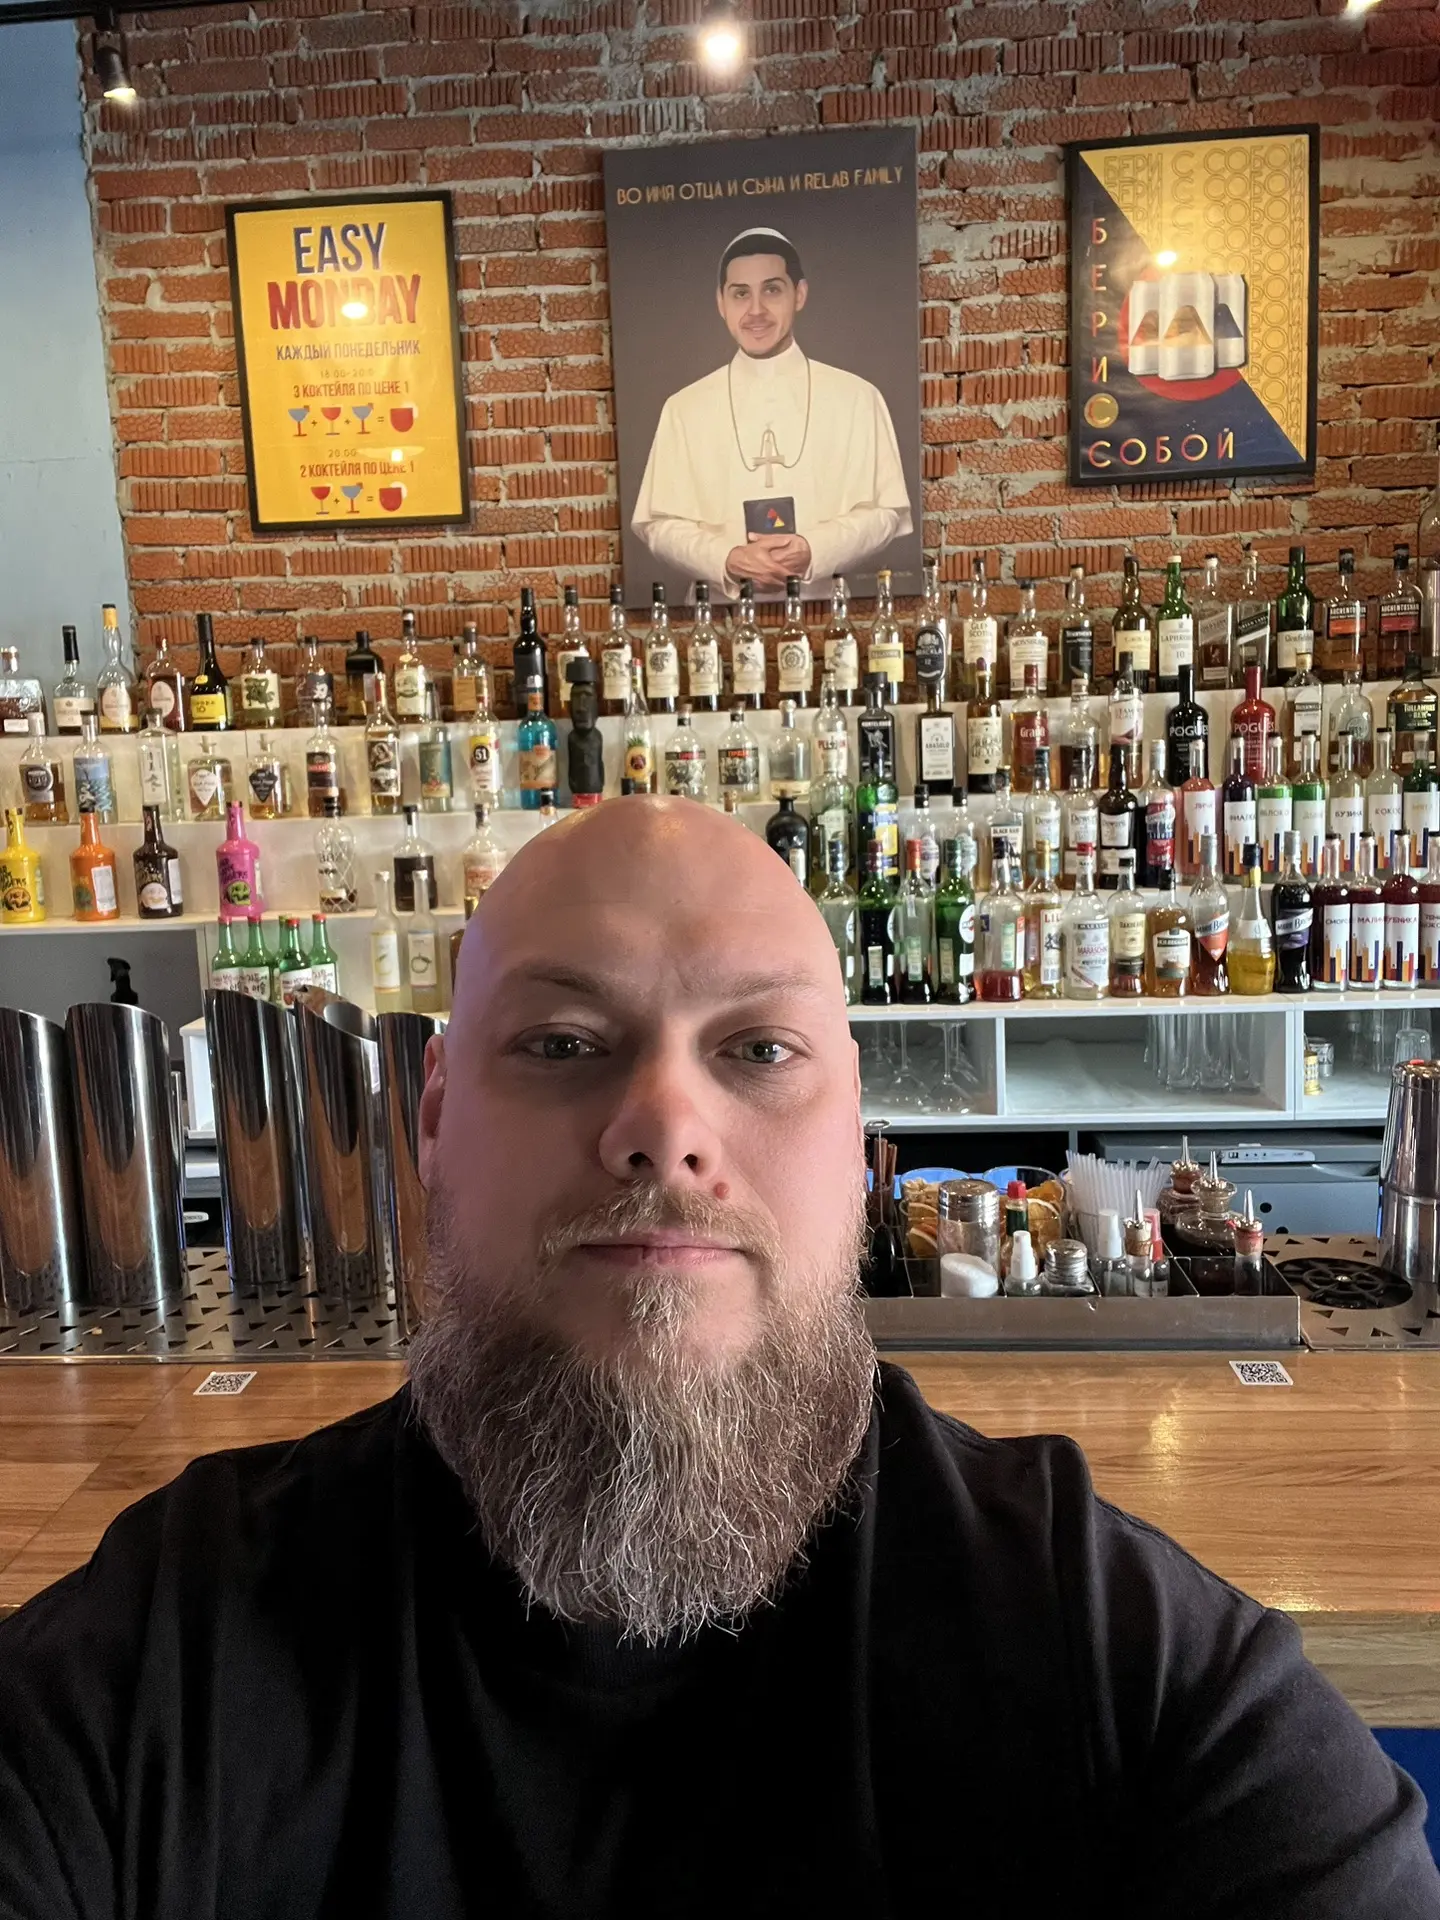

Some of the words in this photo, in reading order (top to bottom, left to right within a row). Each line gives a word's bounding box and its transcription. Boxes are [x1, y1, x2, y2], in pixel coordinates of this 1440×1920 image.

[617, 187, 641, 205] ВО
[646, 184, 675, 203] ИМЯ
[679, 182, 723, 201] ОТЦА
[727, 180, 738, 197] И
[742, 175, 785, 196] СЫНА
[790, 174, 800, 191] И
[804, 170, 849, 190] RELAB
[853, 166, 903, 186] FAMILY
[293, 222, 387, 275] EASY
[267, 273, 422, 330] MONDAY
[276, 342, 332, 361] КАЖДЫЙ
[334, 339, 421, 359] ПОНЕДЕЛЬНИК
[293, 385, 300, 398] 3
[302, 381, 356, 398] КОКТЕЙЛЯ
[357, 382, 372, 396] ПО
[374, 380, 401, 396] ЦЕНЕ
[404, 381, 410, 393] 1
[1088, 427, 1235, 469] СОБОЙ
[300, 464, 307, 478] 2
[309, 461, 360, 478] КОКТЕЙЛЯ
[363, 461, 377, 475] ПО
[410, 460, 415, 473] 1
[474, 747, 488, 761] 51
[1334, 809, 1363, 818] БУЗИНА
